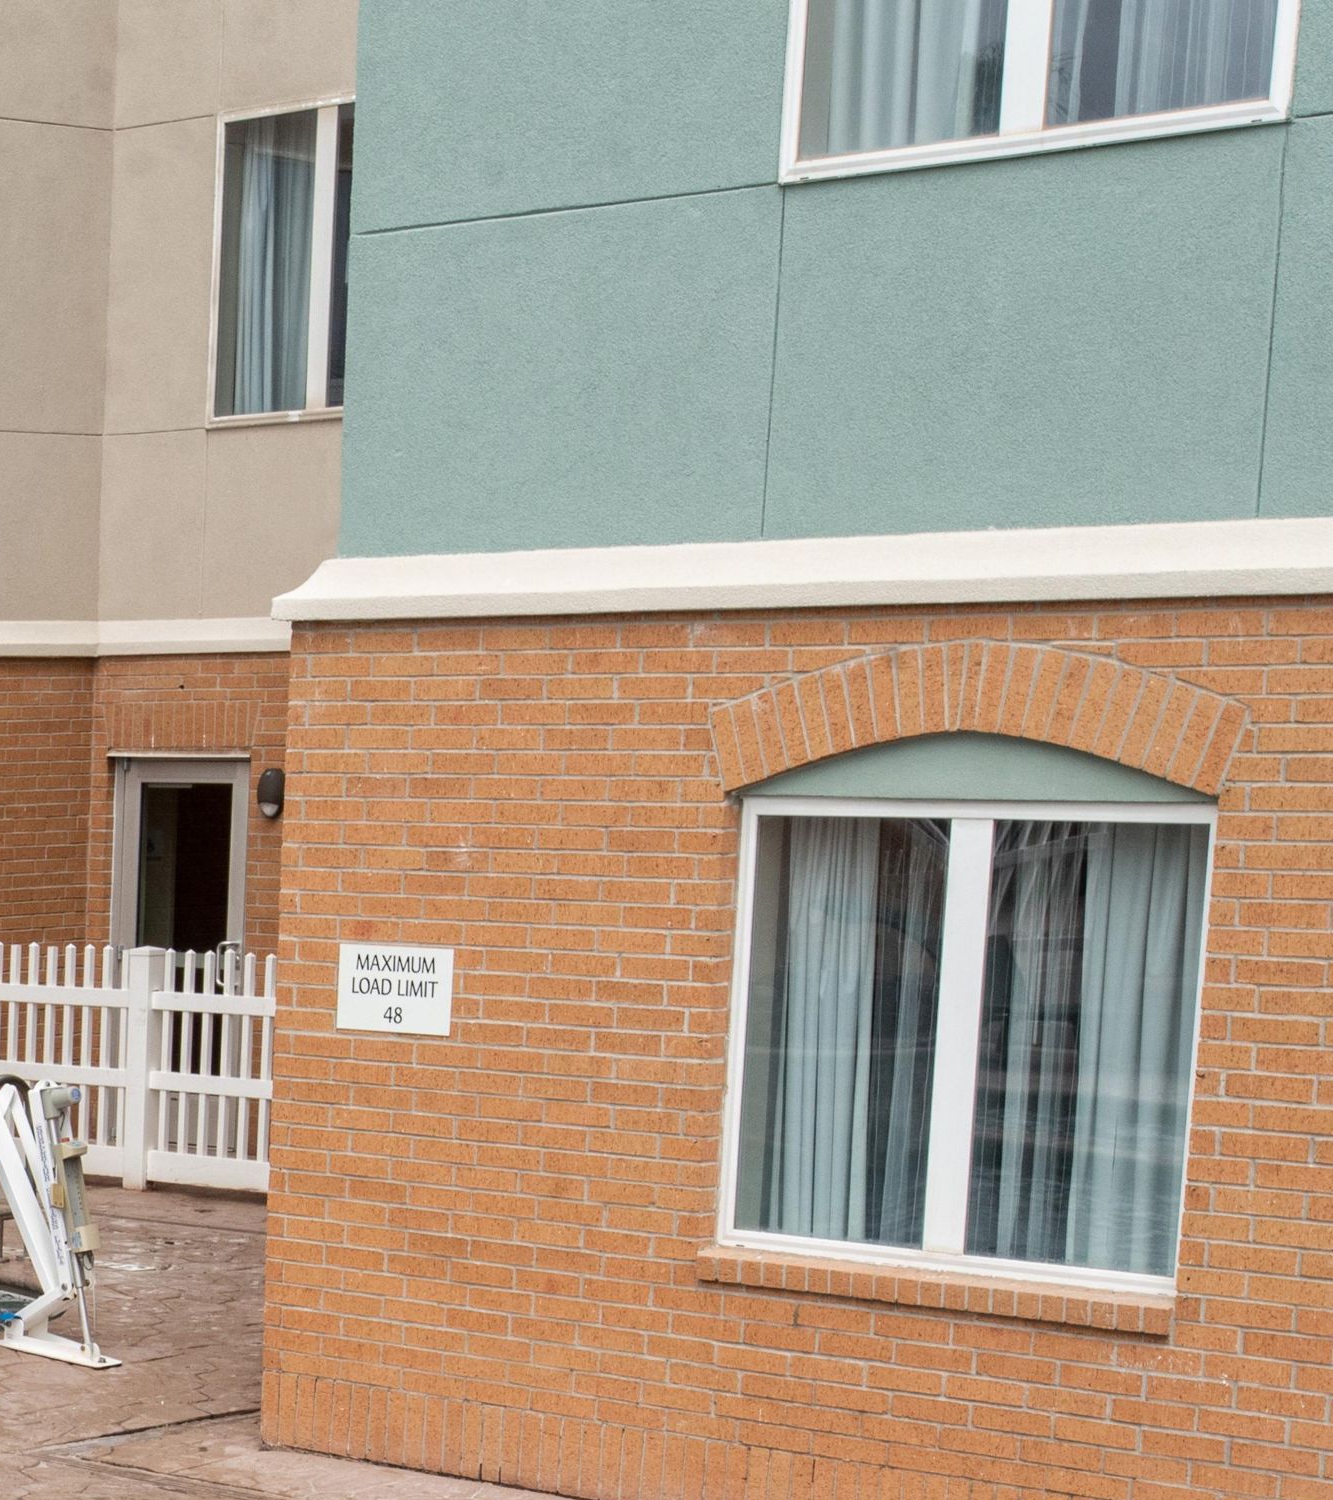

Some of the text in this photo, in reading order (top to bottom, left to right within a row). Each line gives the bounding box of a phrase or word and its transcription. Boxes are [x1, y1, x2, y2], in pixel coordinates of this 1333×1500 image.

[355, 953, 436, 974] MAXIMUM
[352, 976, 439, 998] LOAD LIMIT
[383, 1006, 403, 1024] 48
